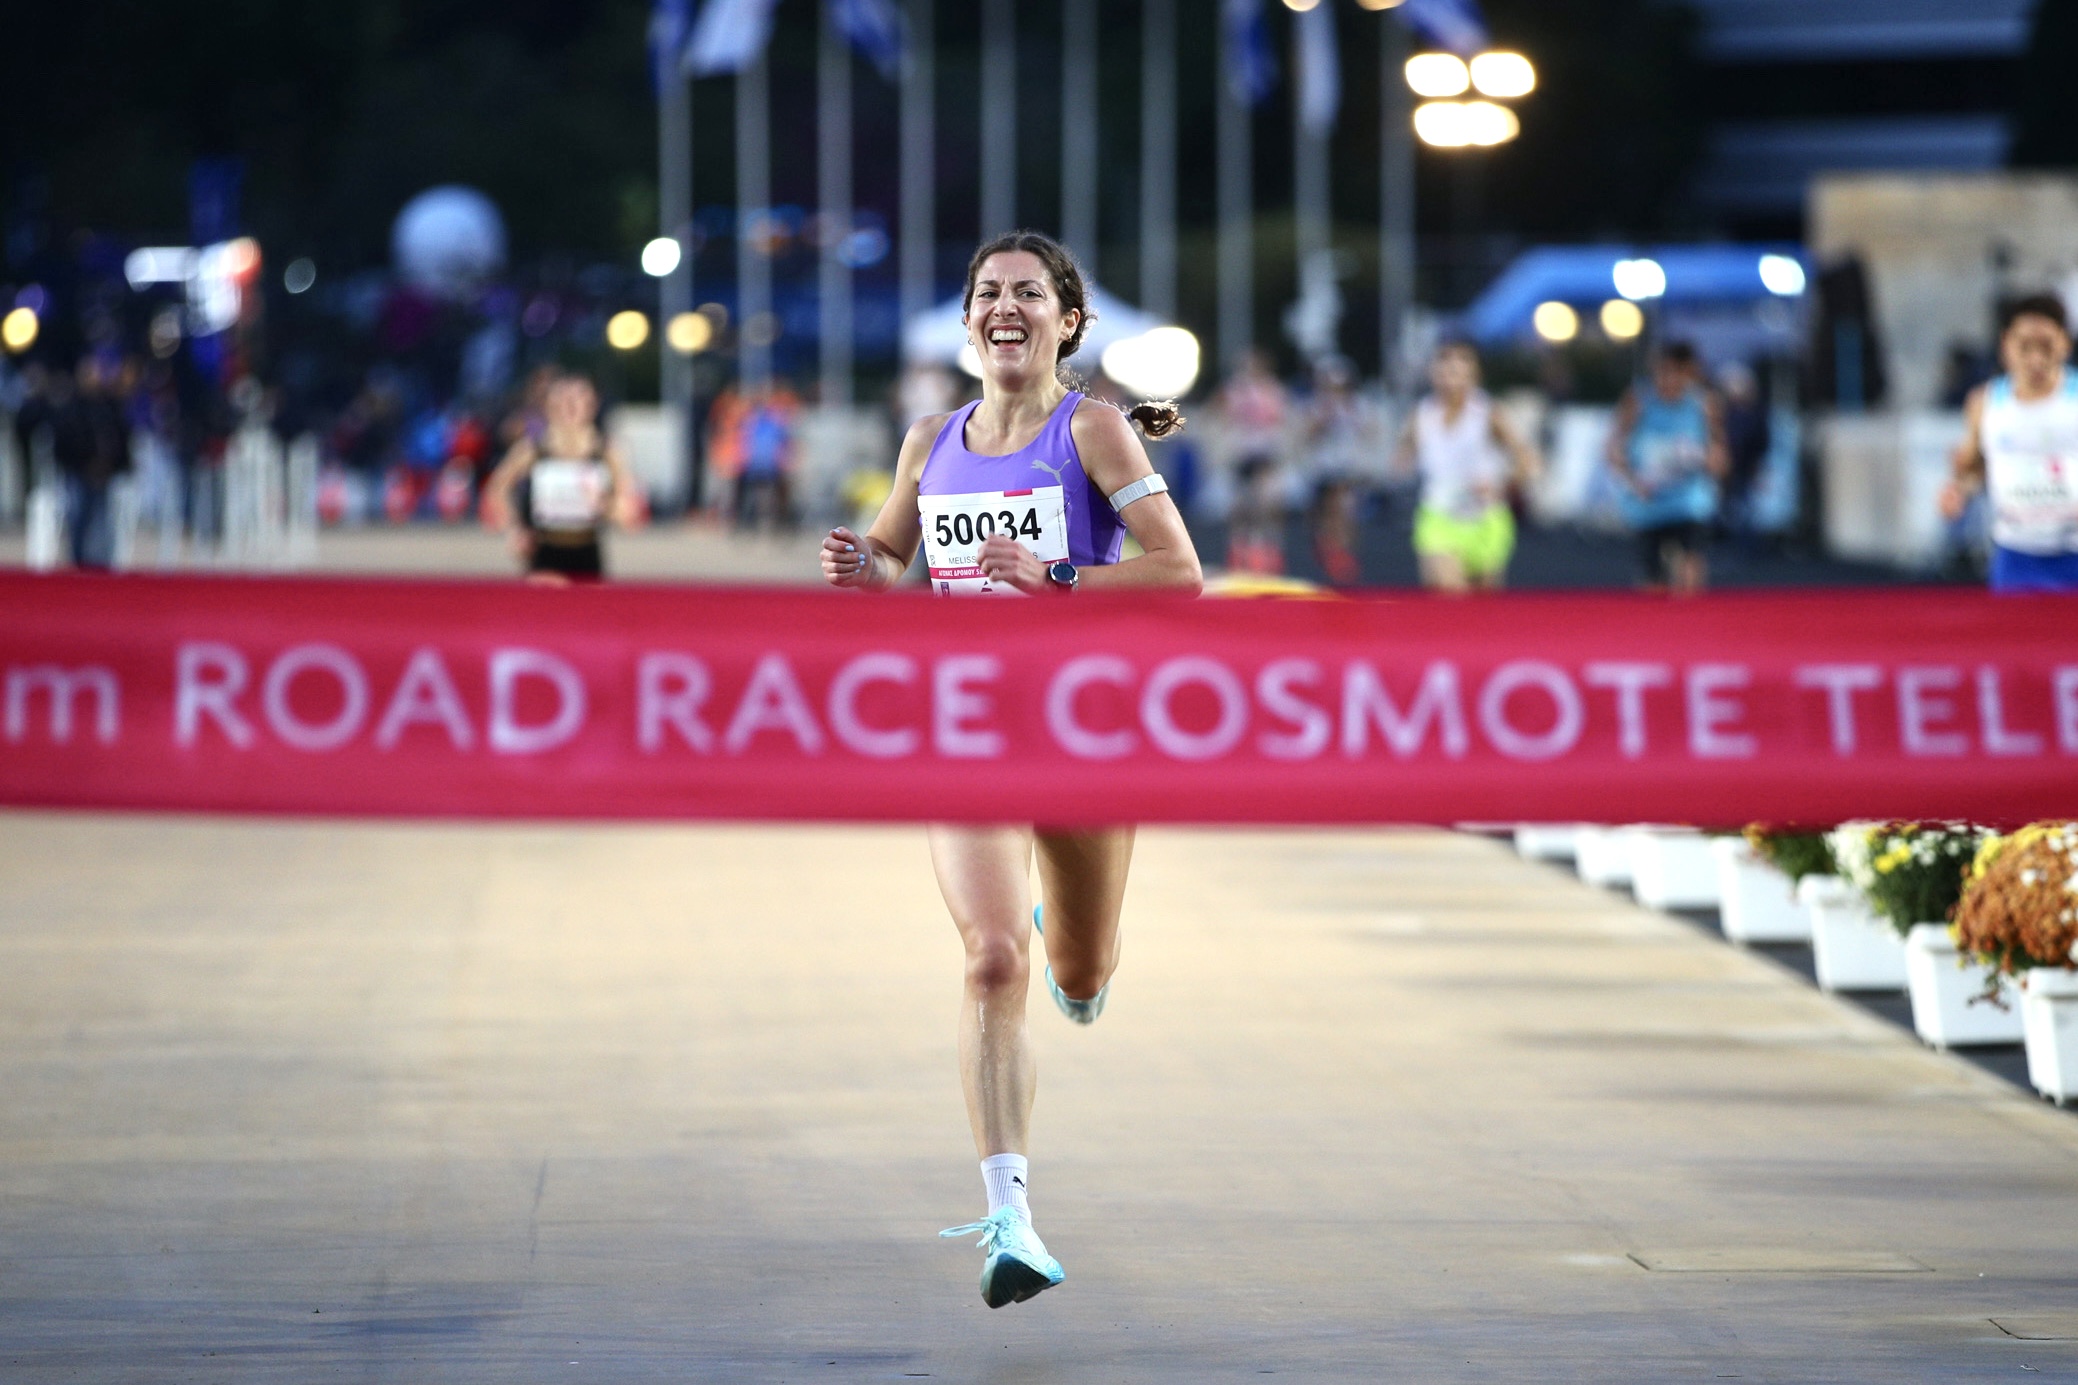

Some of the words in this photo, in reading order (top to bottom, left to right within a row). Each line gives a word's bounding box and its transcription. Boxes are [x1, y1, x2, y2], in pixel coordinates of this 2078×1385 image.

[936, 508, 1042, 547] 50034
[948, 556, 976, 565] MELISS
[173, 641, 588, 754] ROAD
[635, 652, 1002, 759] RACE
[1045, 655, 1758, 761] COSMOTE
